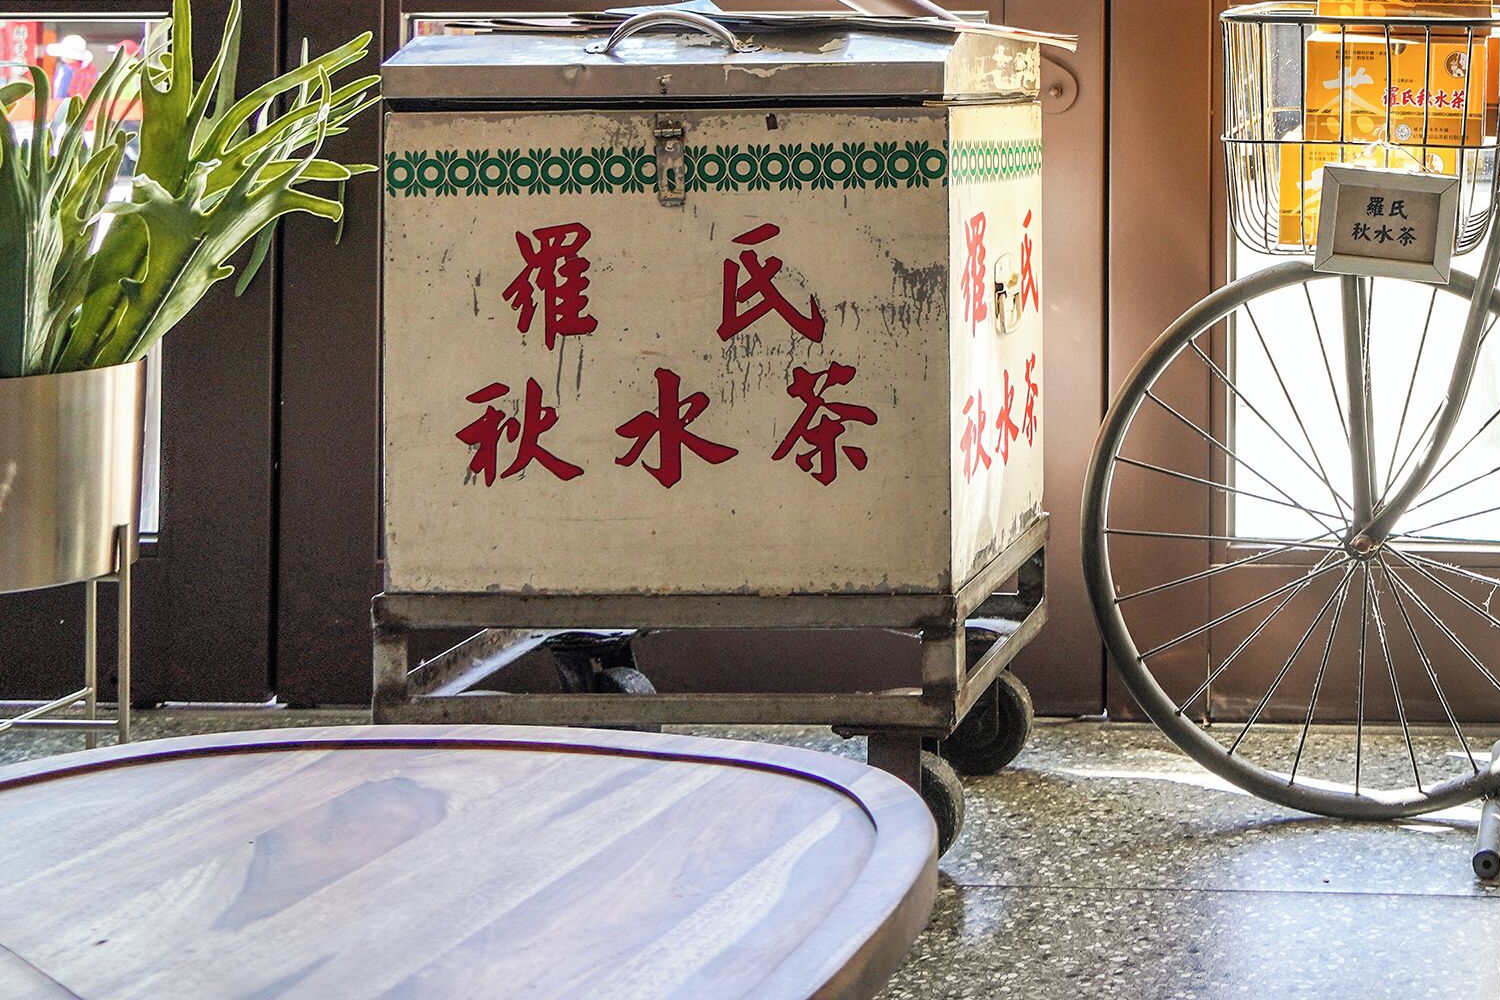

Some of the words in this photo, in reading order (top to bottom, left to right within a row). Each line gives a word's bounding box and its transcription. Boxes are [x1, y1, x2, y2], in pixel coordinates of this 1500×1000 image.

[1382, 86, 1466, 109] 羅氏秋水茶
[1351, 222, 1417, 247] 秋水茶
[1366, 196, 1409, 220] 羅氏
[502, 221, 825, 351] 羅氏
[960, 209, 1039, 338] 羅氏
[455, 360, 877, 489] 秋水茶
[960, 352, 1039, 485] 秋水茶
